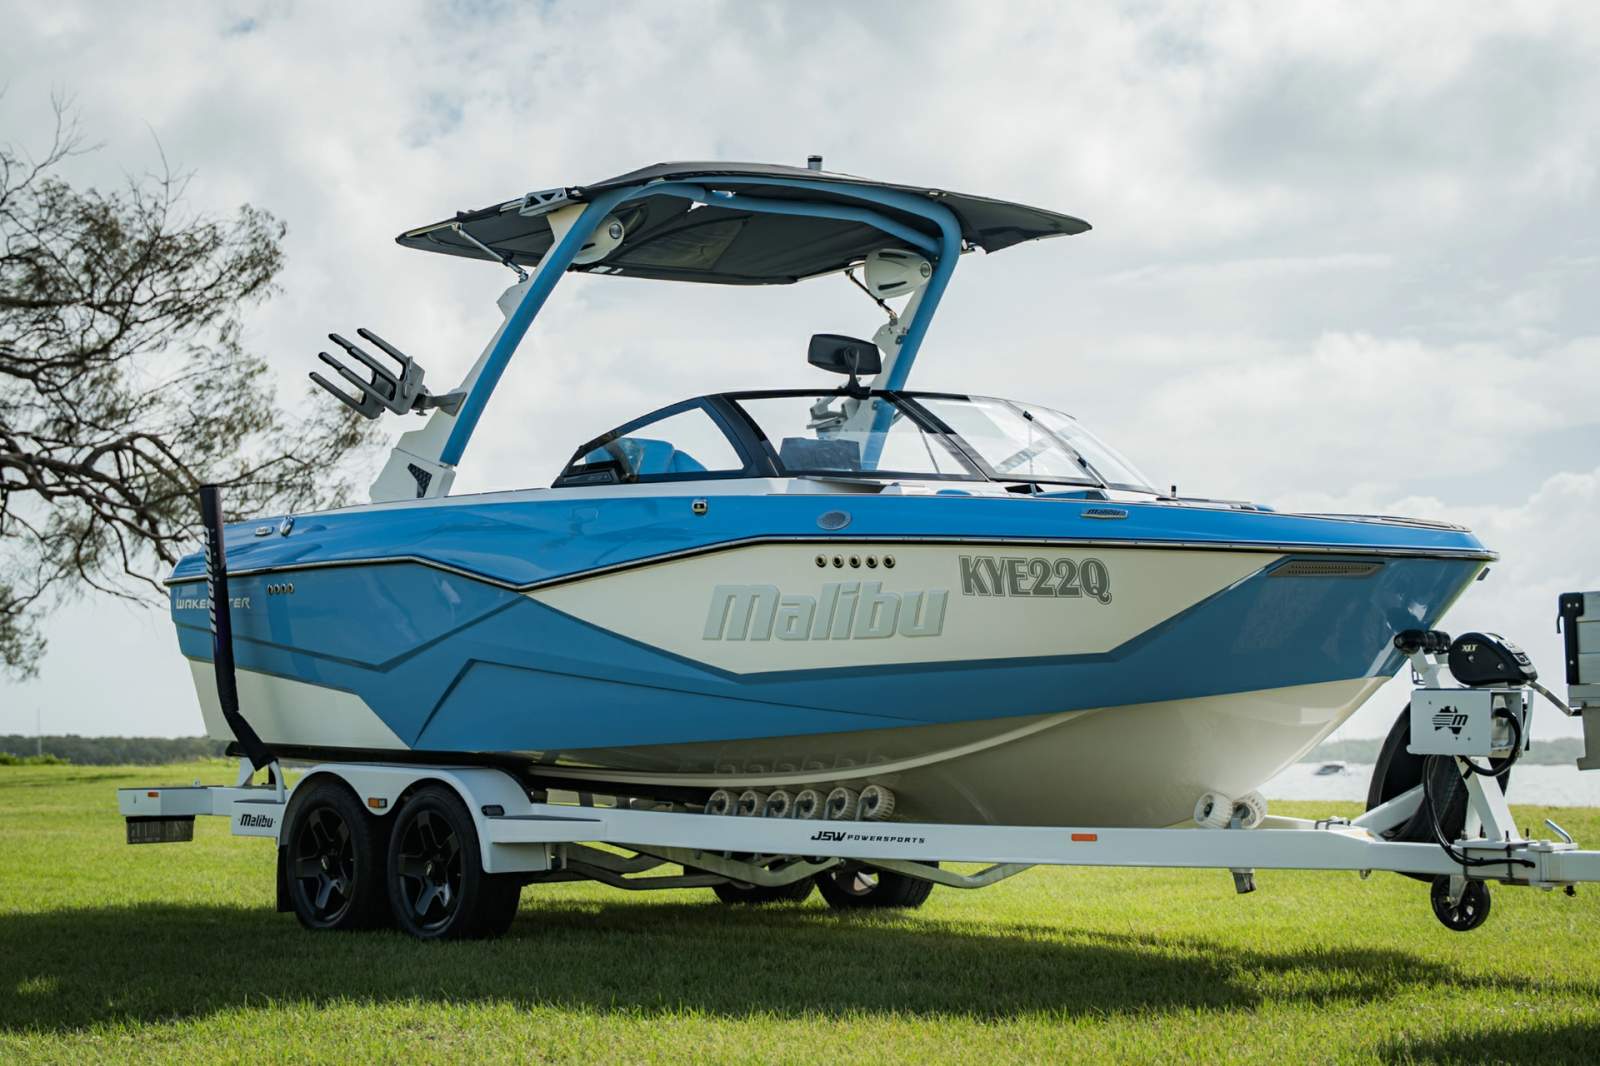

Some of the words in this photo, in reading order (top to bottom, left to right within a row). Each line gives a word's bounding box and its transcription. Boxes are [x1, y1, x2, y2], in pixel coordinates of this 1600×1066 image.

[958, 555, 1112, 605] KYE22Q
[702, 581, 950, 641] Malibu
[240, 813, 274, 828] Malibu
[811, 831, 847, 842] JSW
[847, 834, 925, 844] POWERSPORTS
